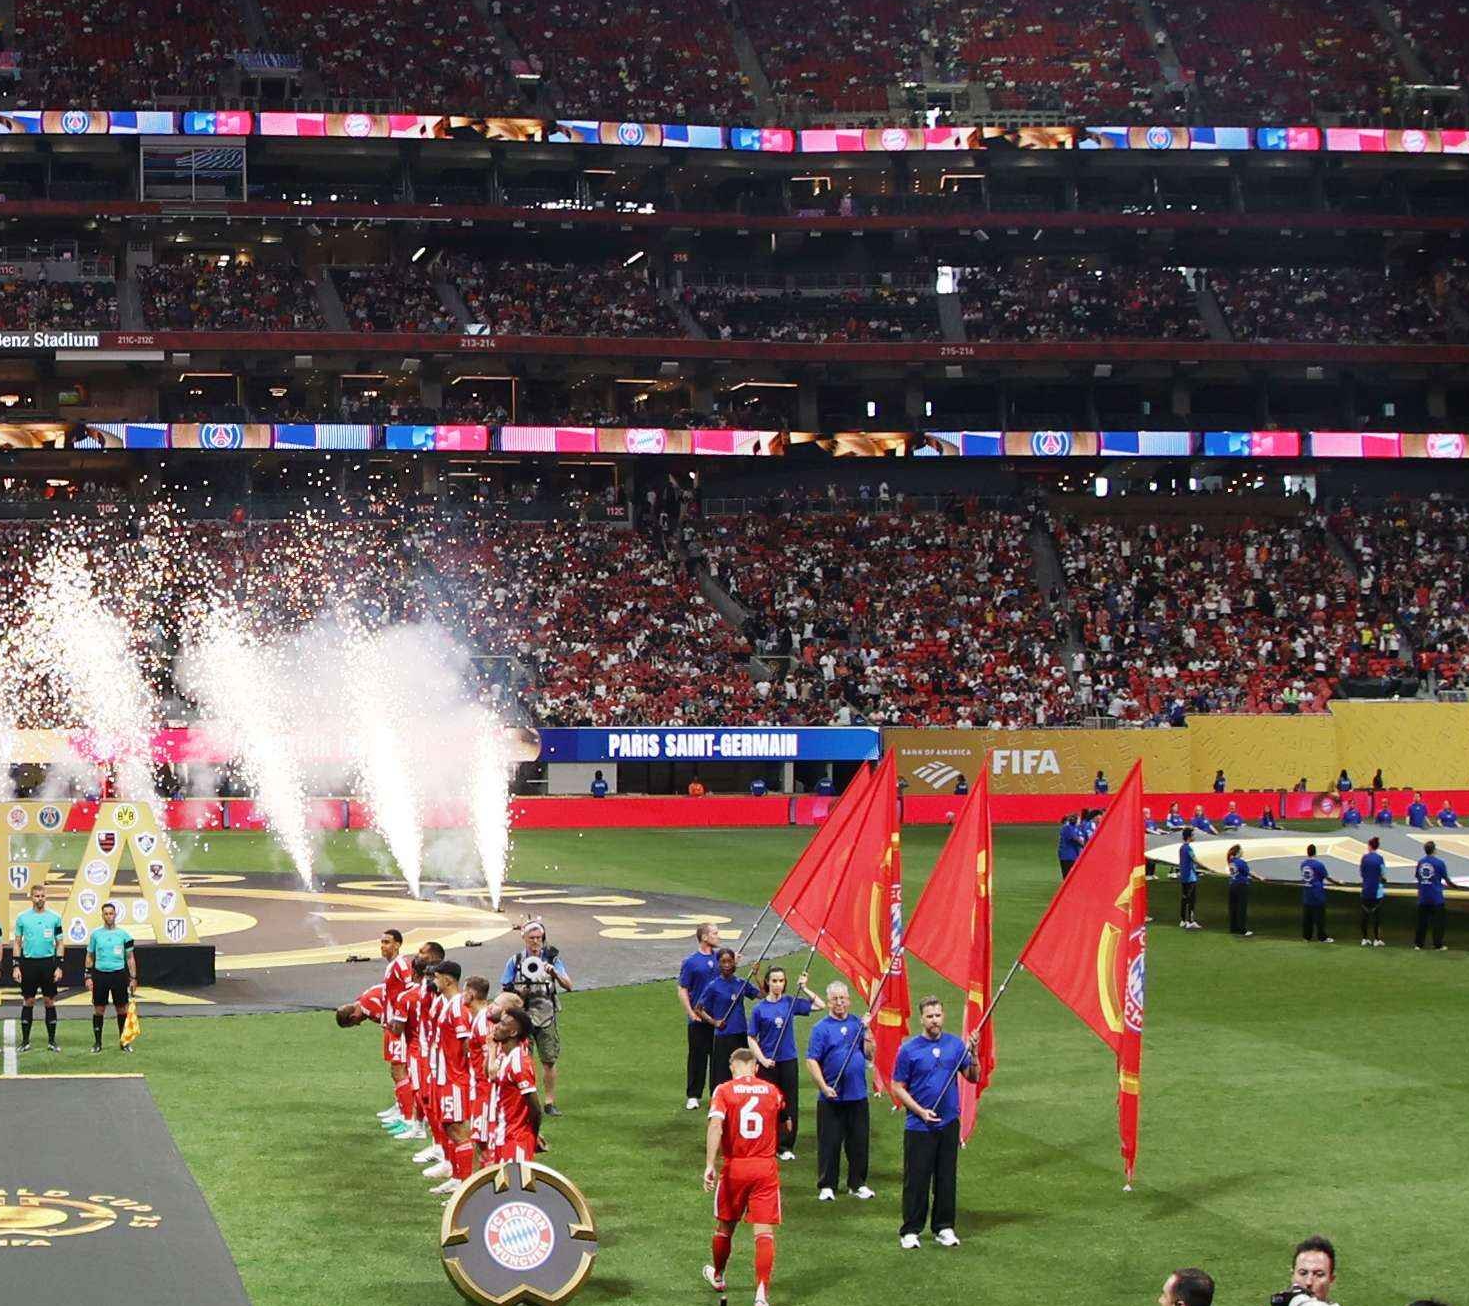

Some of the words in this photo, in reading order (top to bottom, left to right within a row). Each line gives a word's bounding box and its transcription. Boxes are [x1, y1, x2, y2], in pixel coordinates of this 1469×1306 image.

[34, 331, 100, 350] Stadium
[608, 732, 661, 758] PARIS
[665, 731, 799, 758] SAINT-GERMAIN
[934, 748, 972, 756] AMERICA
[992, 749, 1061, 775] FIFA
[739, 1096, 764, 1139] 6
[86, 1190, 148, 1216] CUP
[501, 1205, 548, 1233] BAYERN
